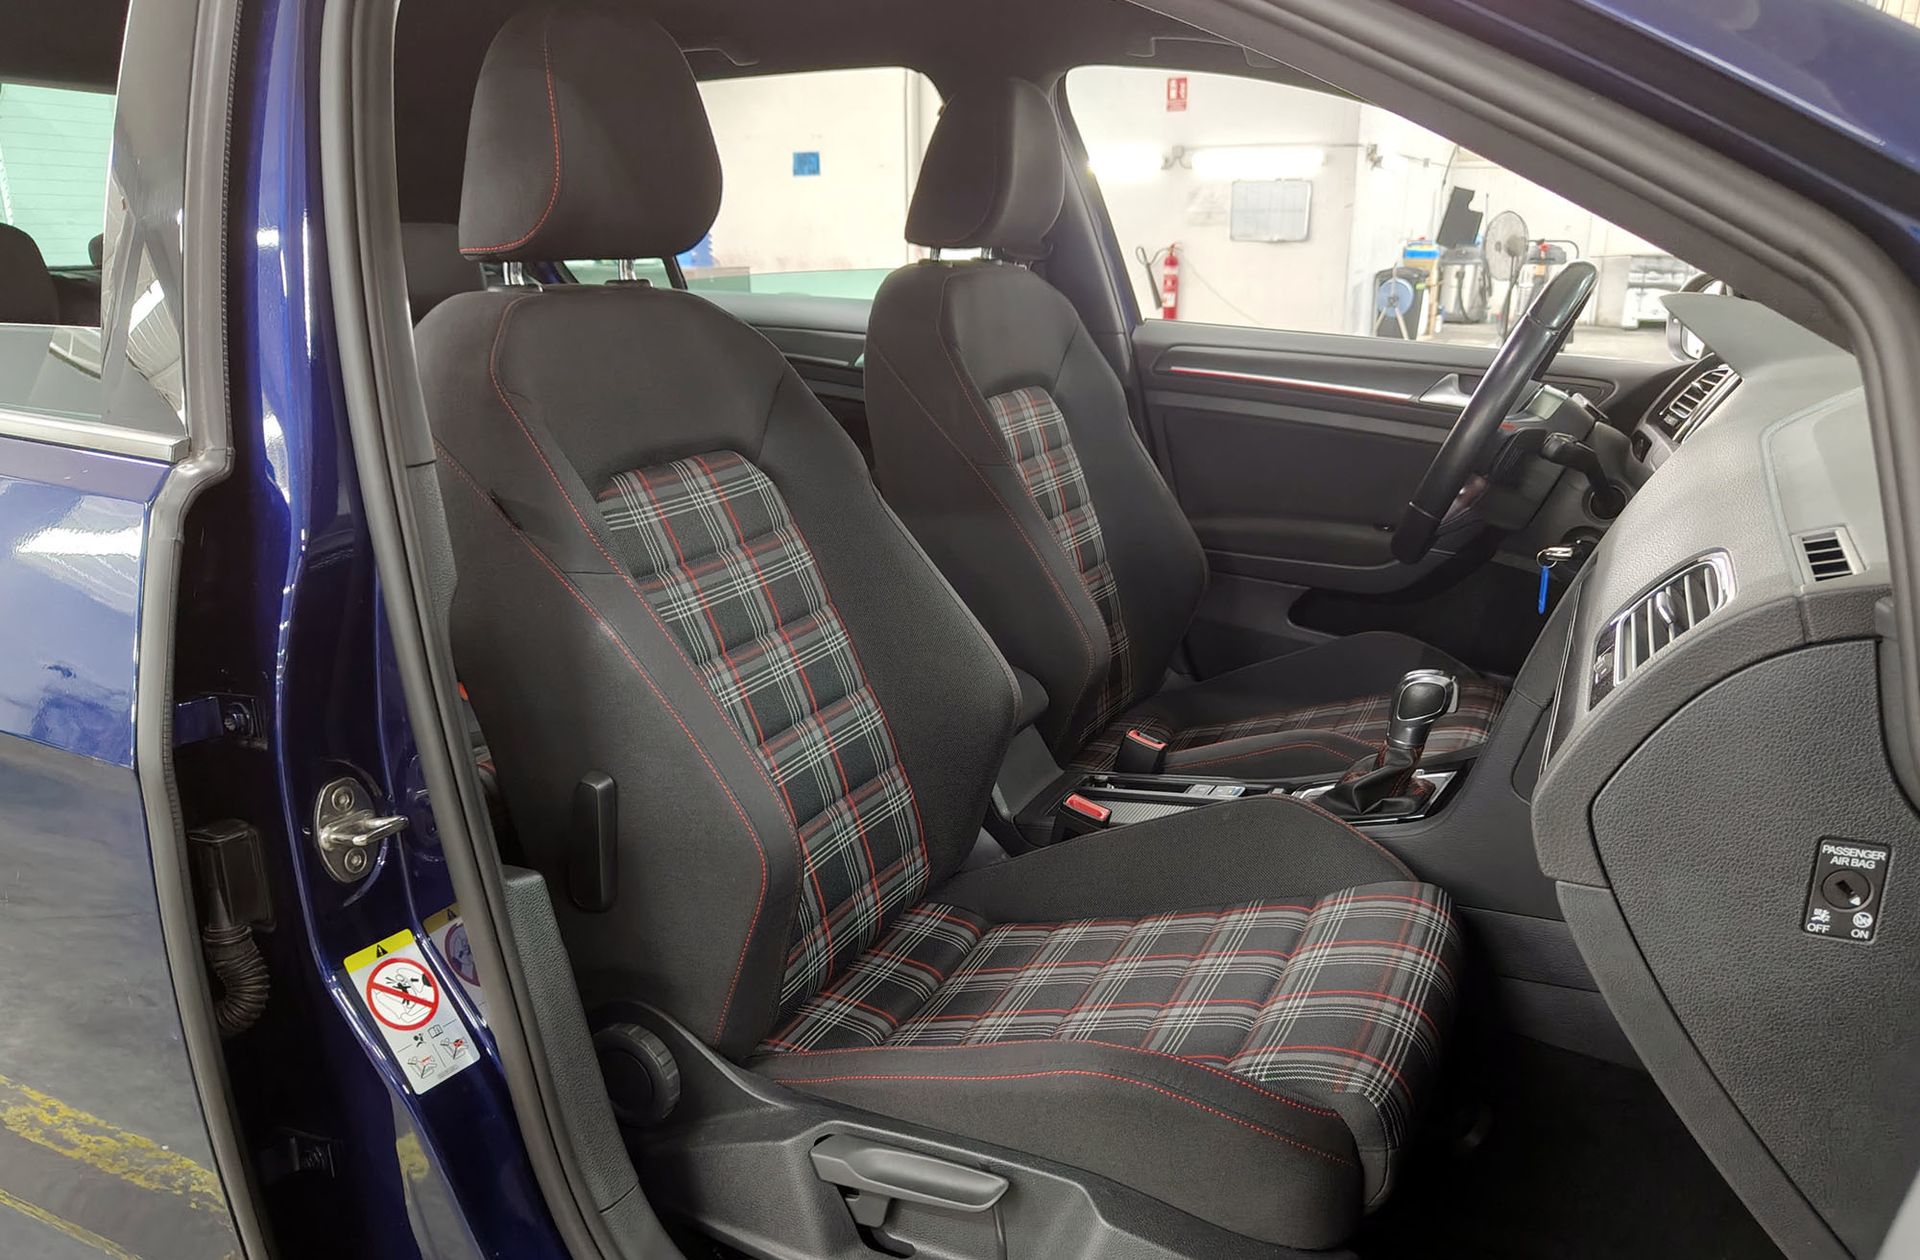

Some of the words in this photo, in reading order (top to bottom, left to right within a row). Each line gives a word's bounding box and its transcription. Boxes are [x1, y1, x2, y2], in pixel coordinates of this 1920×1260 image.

[1822, 844, 1886, 861] PASSENGER
[1830, 856, 1849, 866] AIR
[1850, 858, 1876, 869] BAG
[1807, 923, 1830, 933] OFF
[1850, 929, 1869, 939] ON
